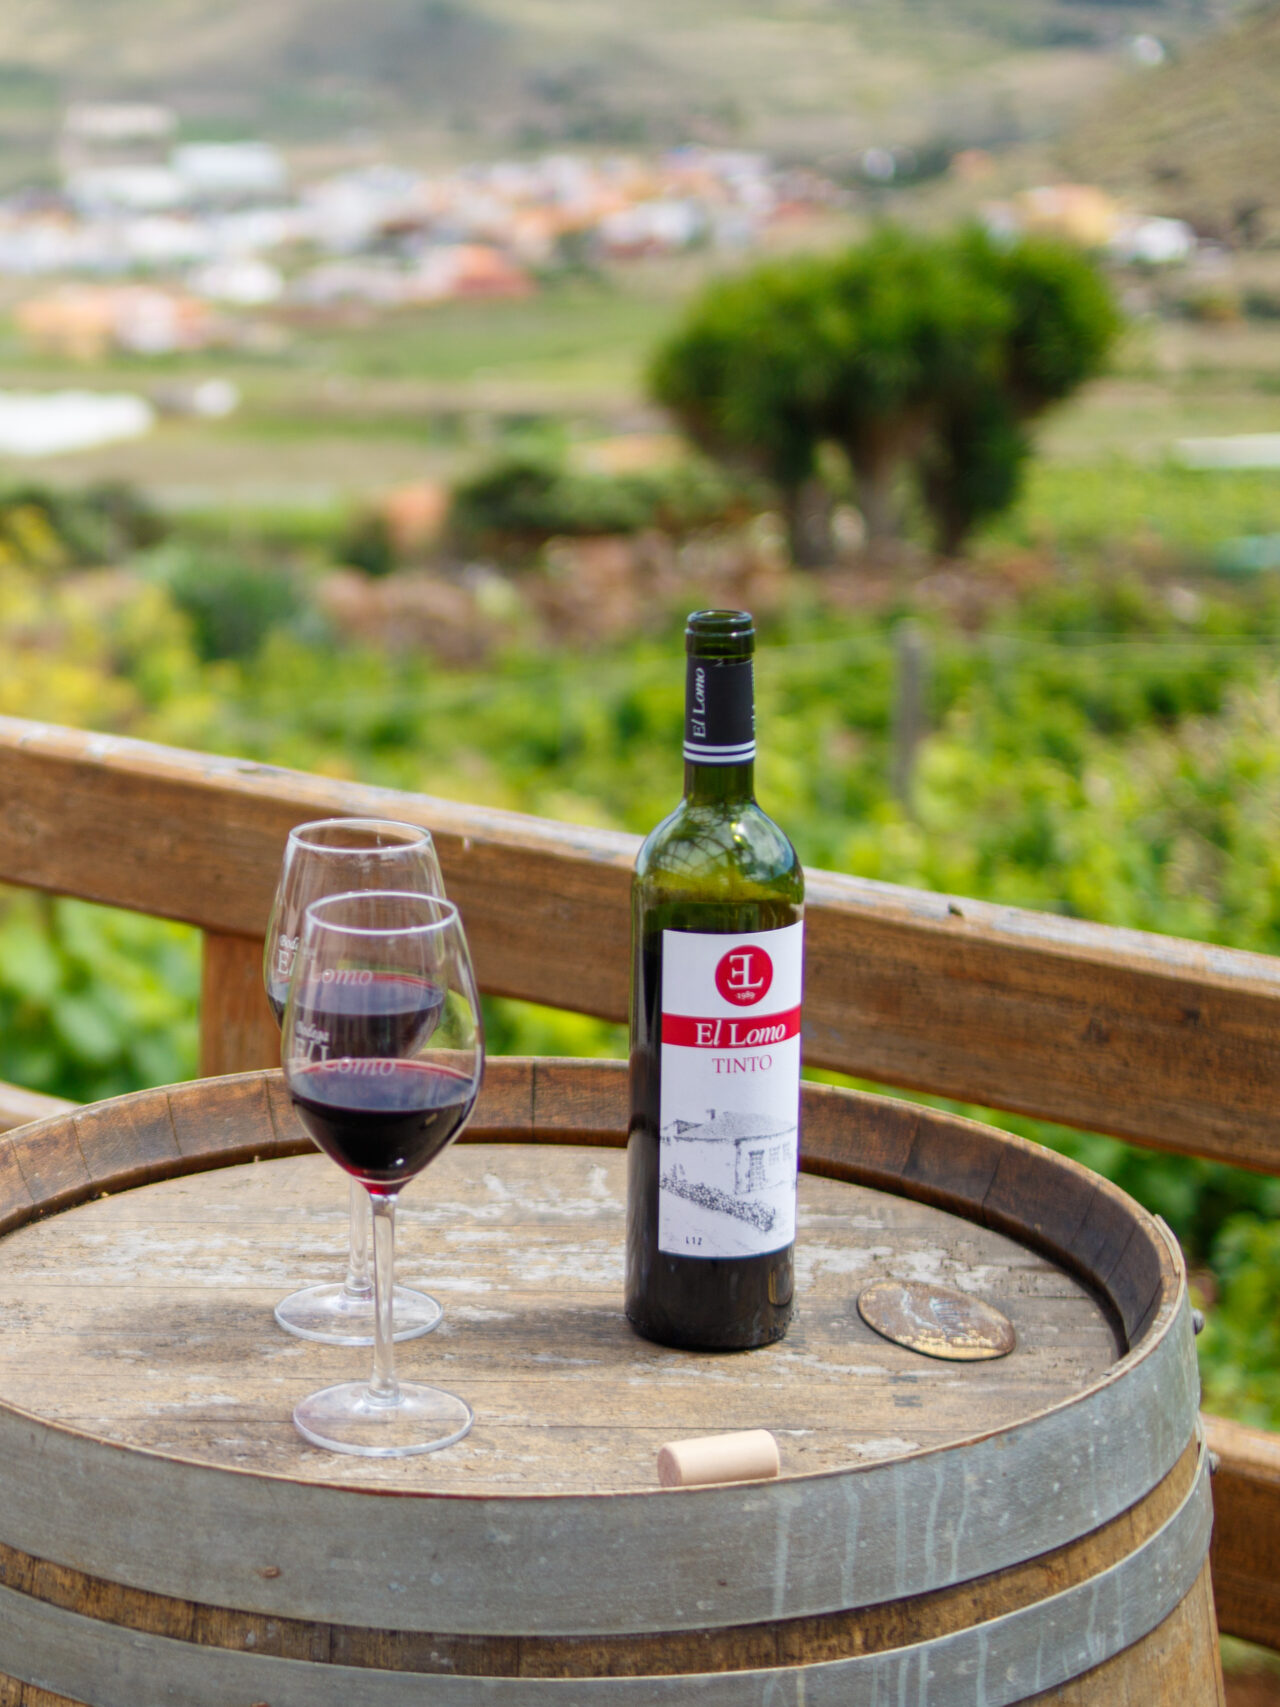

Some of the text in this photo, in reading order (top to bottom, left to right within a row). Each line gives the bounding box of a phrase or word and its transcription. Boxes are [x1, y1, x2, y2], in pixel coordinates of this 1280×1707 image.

[690, 666, 706, 738] El Lomo
[694, 1019, 787, 1047] El Lomo
[320, 1044, 396, 1077] Lomo
[711, 1054, 773, 1074] TINTO
